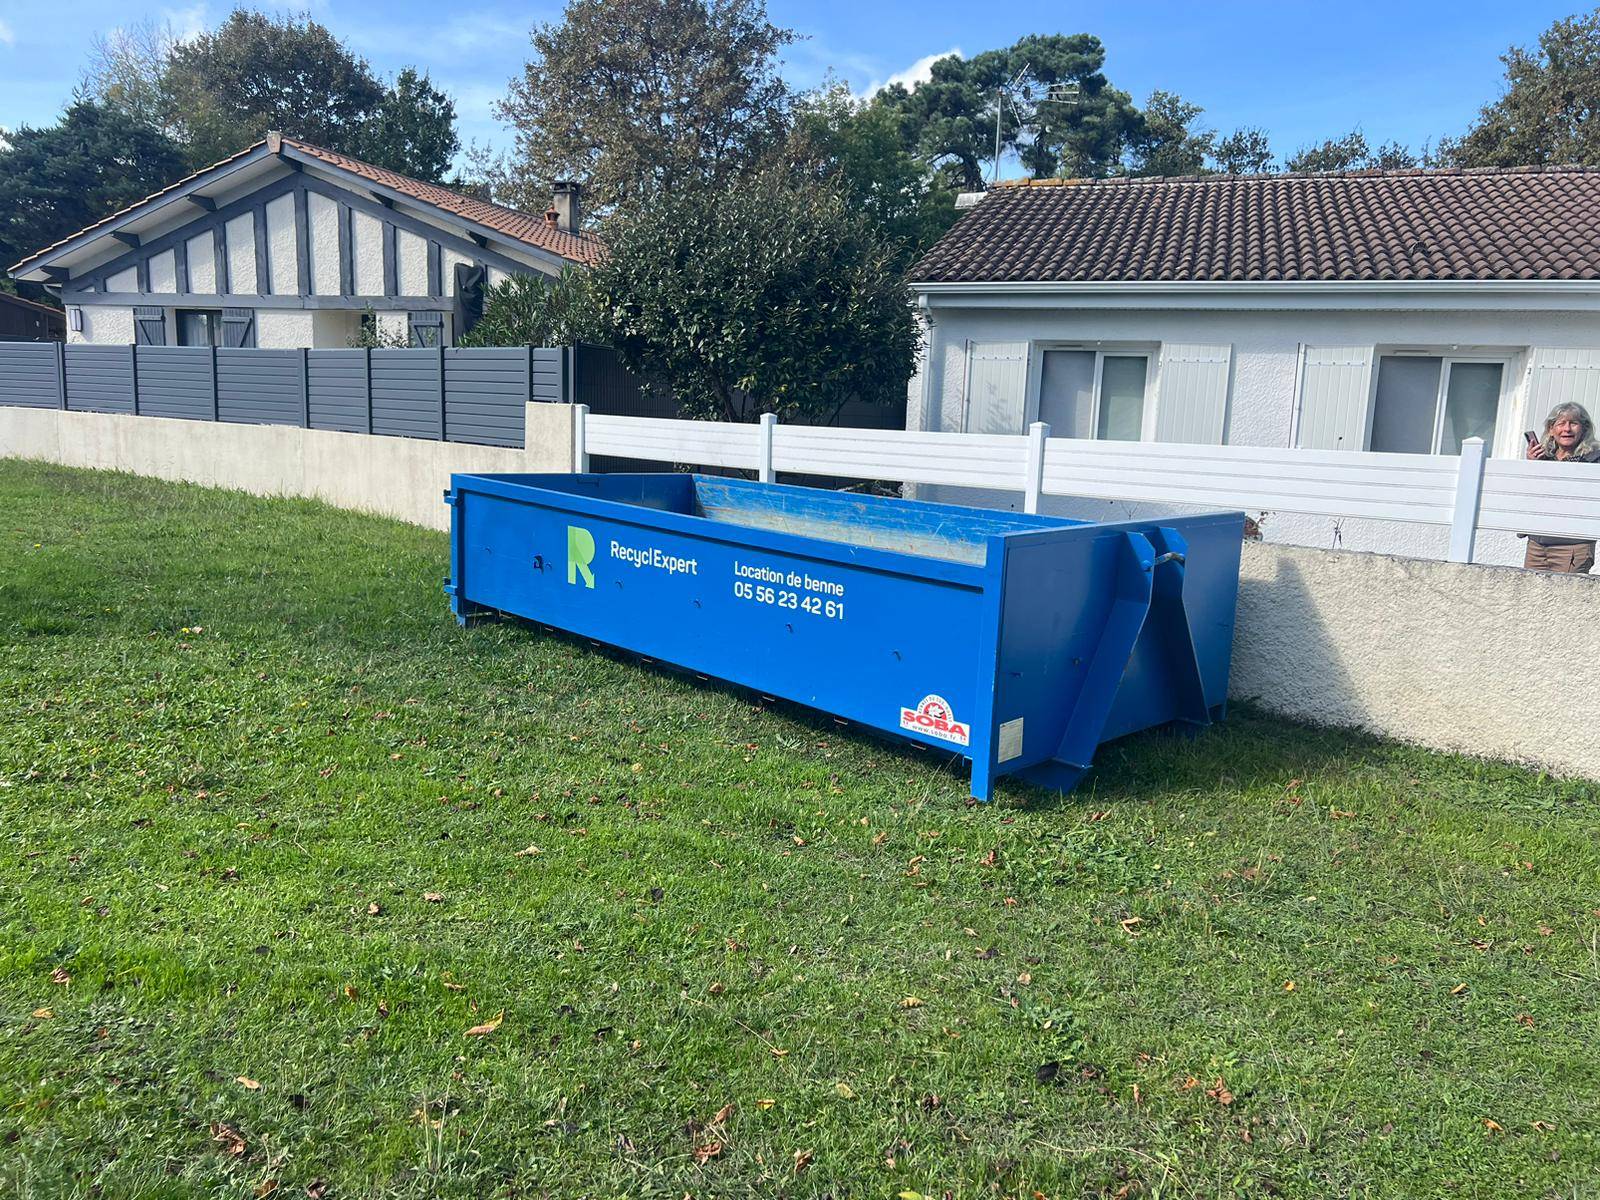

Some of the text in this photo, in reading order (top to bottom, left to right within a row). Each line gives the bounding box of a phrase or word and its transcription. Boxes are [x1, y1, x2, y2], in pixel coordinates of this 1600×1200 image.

[568, 525, 596, 589] R
[611, 541, 697, 574] RecyclExpert
[734, 561, 844, 597] Location de benne
[734, 581, 844, 619] 05 56 23 42 61
[903, 711, 967, 737] SOBA
